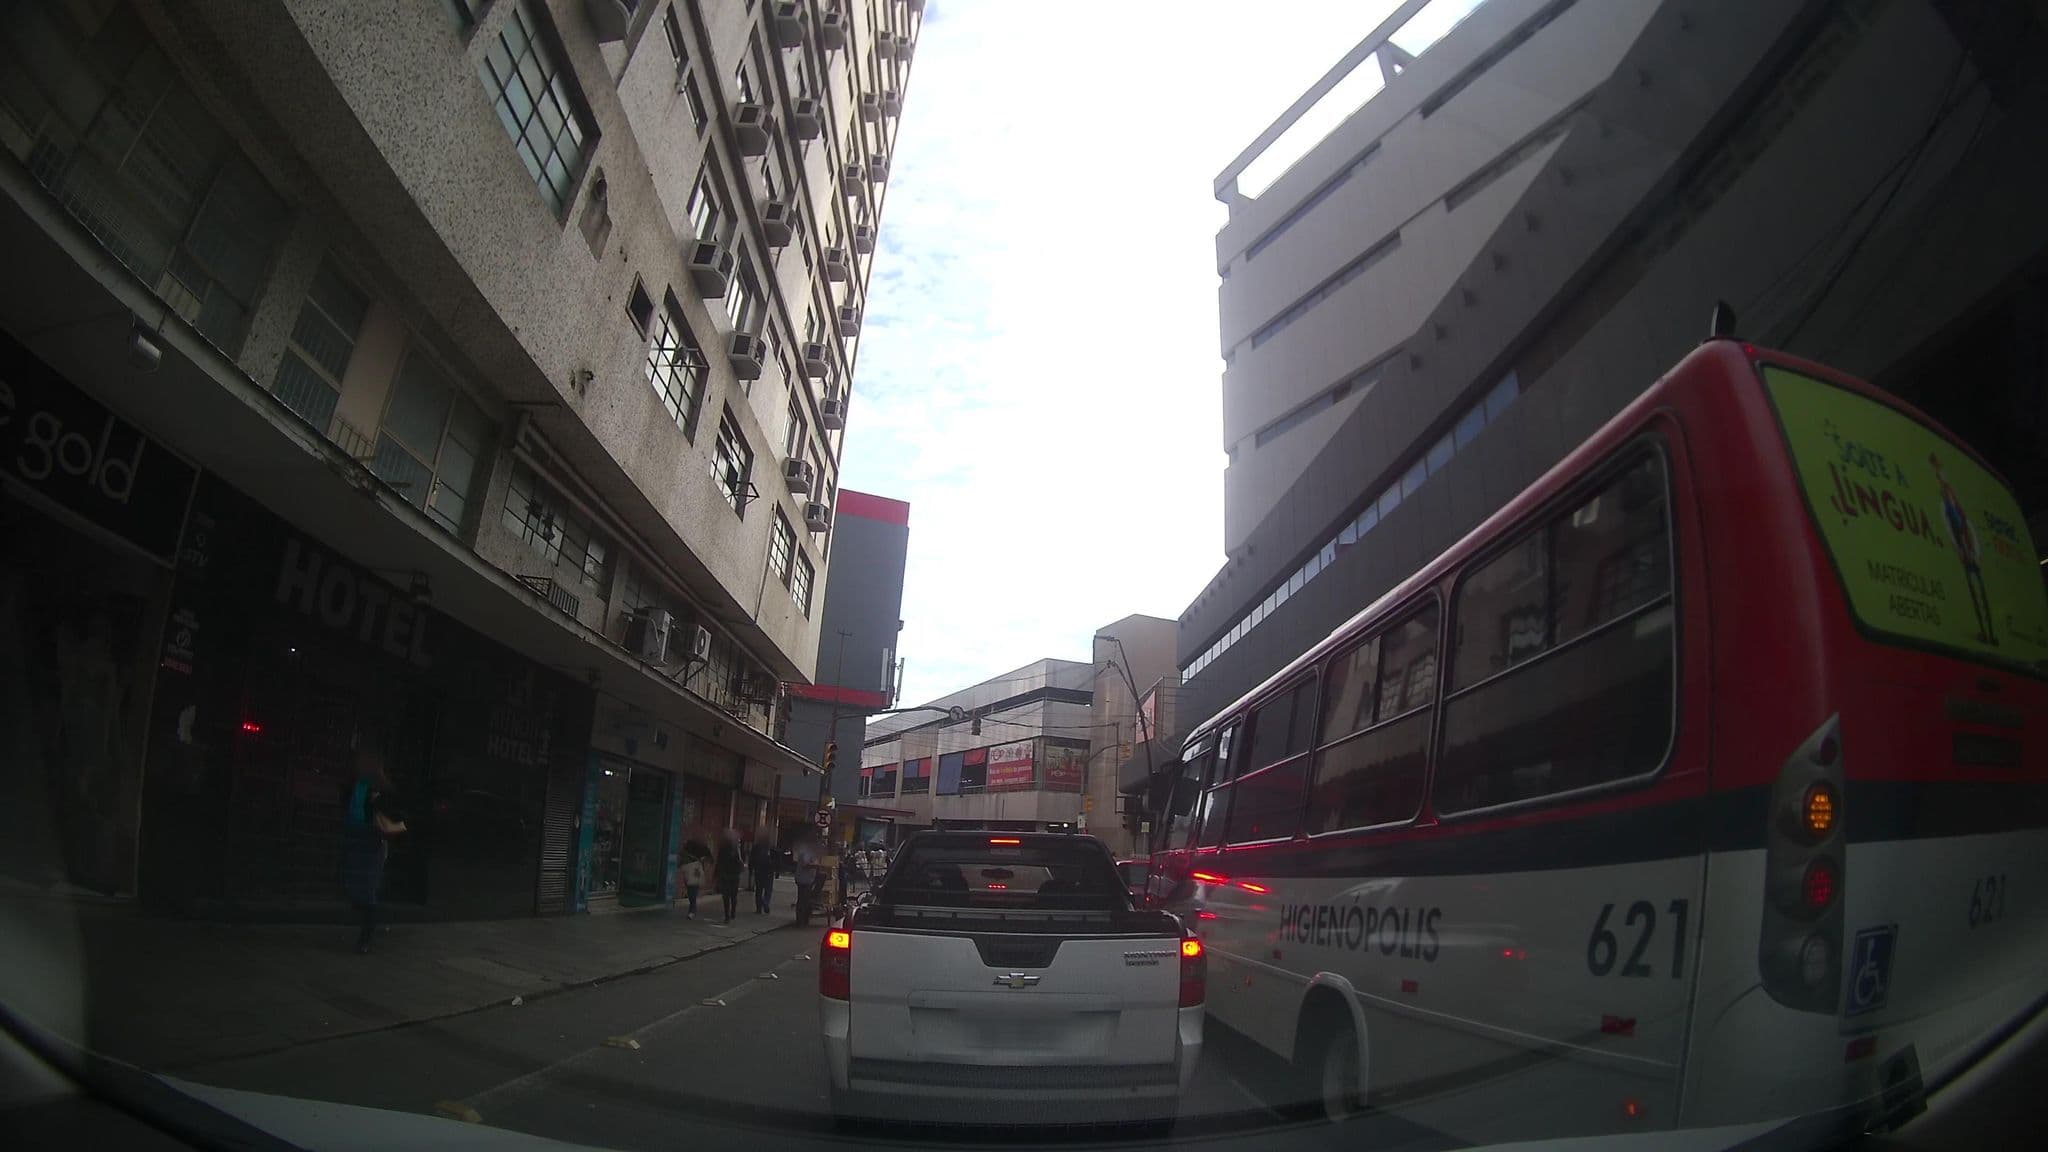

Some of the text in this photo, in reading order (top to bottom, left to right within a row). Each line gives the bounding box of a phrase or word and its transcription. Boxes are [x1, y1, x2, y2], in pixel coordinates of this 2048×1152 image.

[16, 411, 147, 505] gold
[275, 537, 433, 673] HOTEL
[1279, 895, 1442, 963] HIGIENÓPOLIS
[1586, 899, 1690, 980] 621
[1967, 873, 2007, 930] 621
